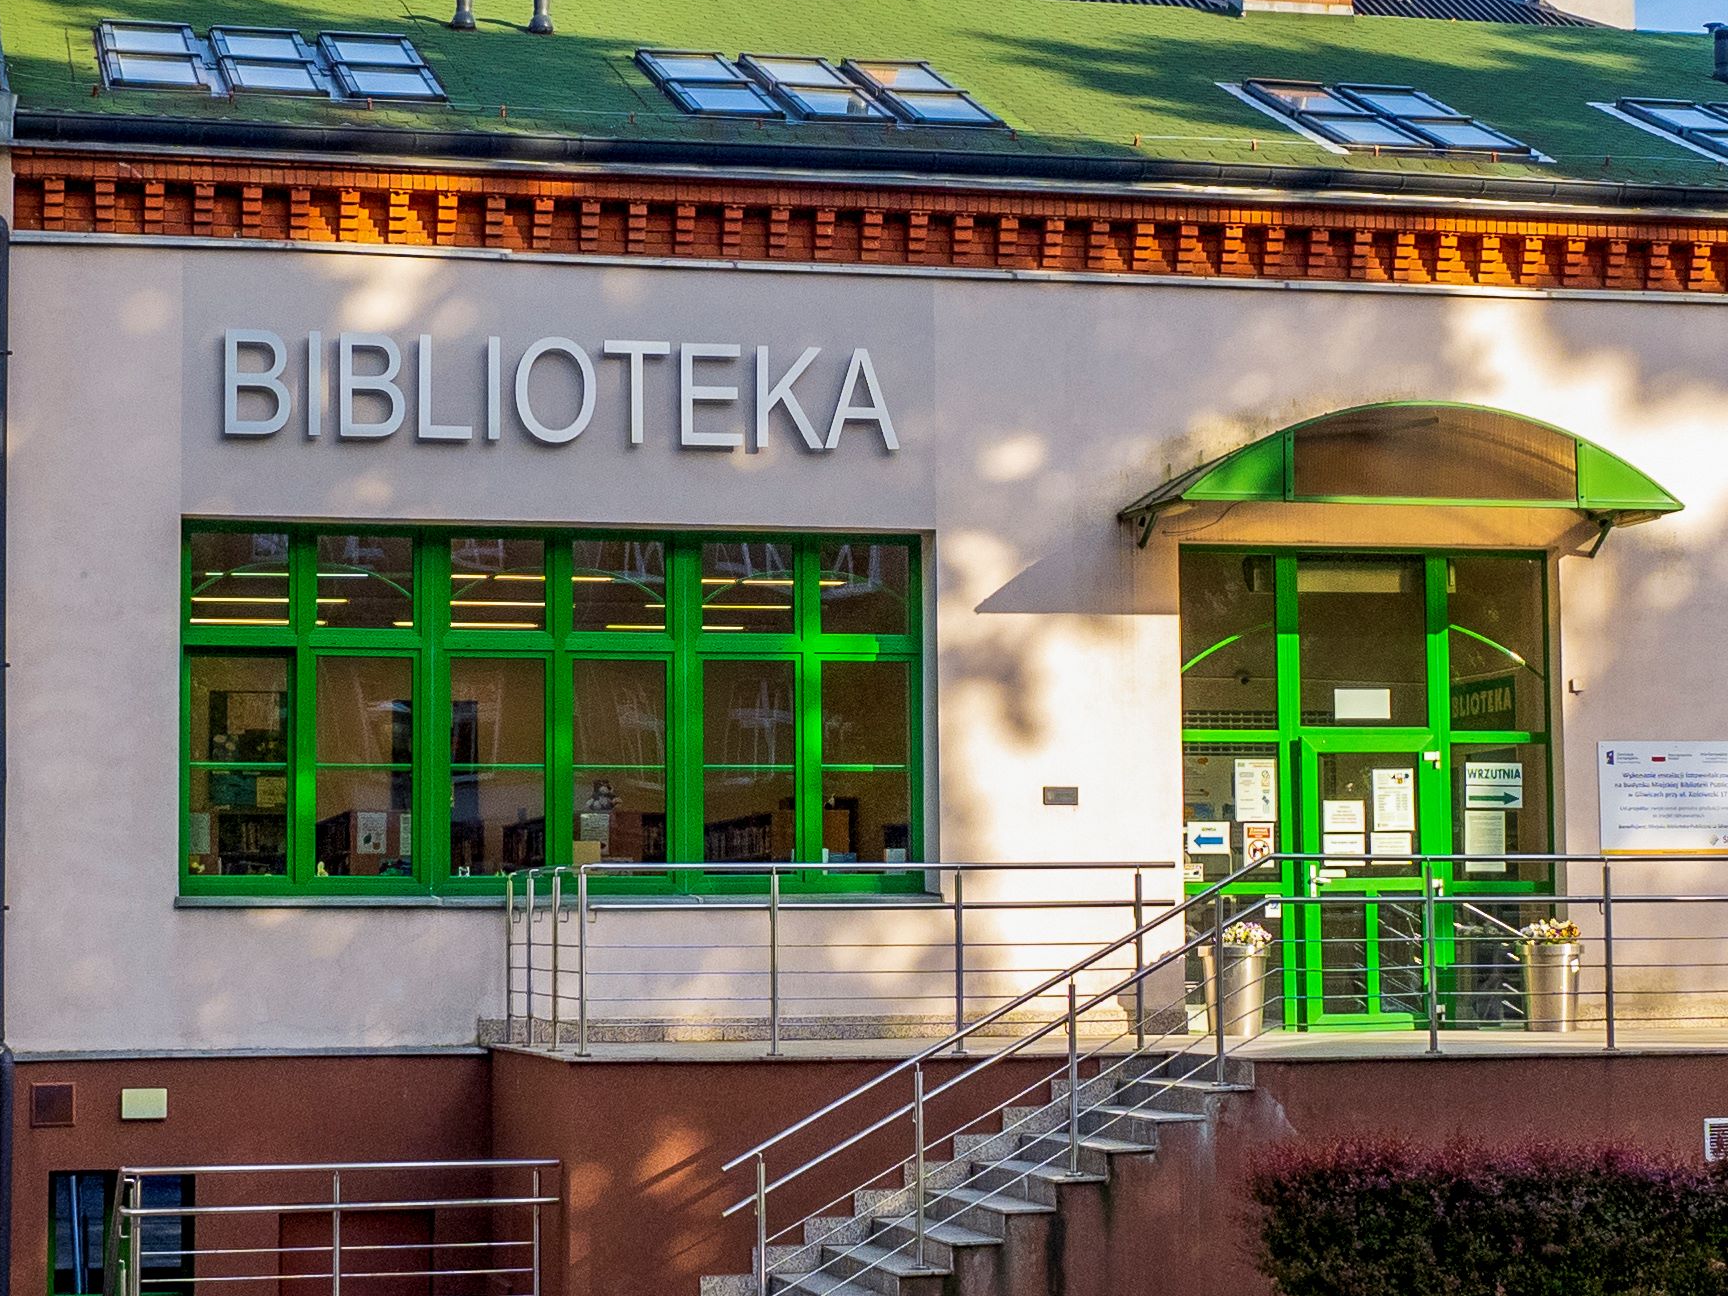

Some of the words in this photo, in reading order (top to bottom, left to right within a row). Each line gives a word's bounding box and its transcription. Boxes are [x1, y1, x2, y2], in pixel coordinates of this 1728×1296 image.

[223, 328, 901, 452] BIBLIOTEKA
[1452, 687, 1512, 718] BLIOTEKA
[1467, 768, 1522, 780] WRZUTNIA
